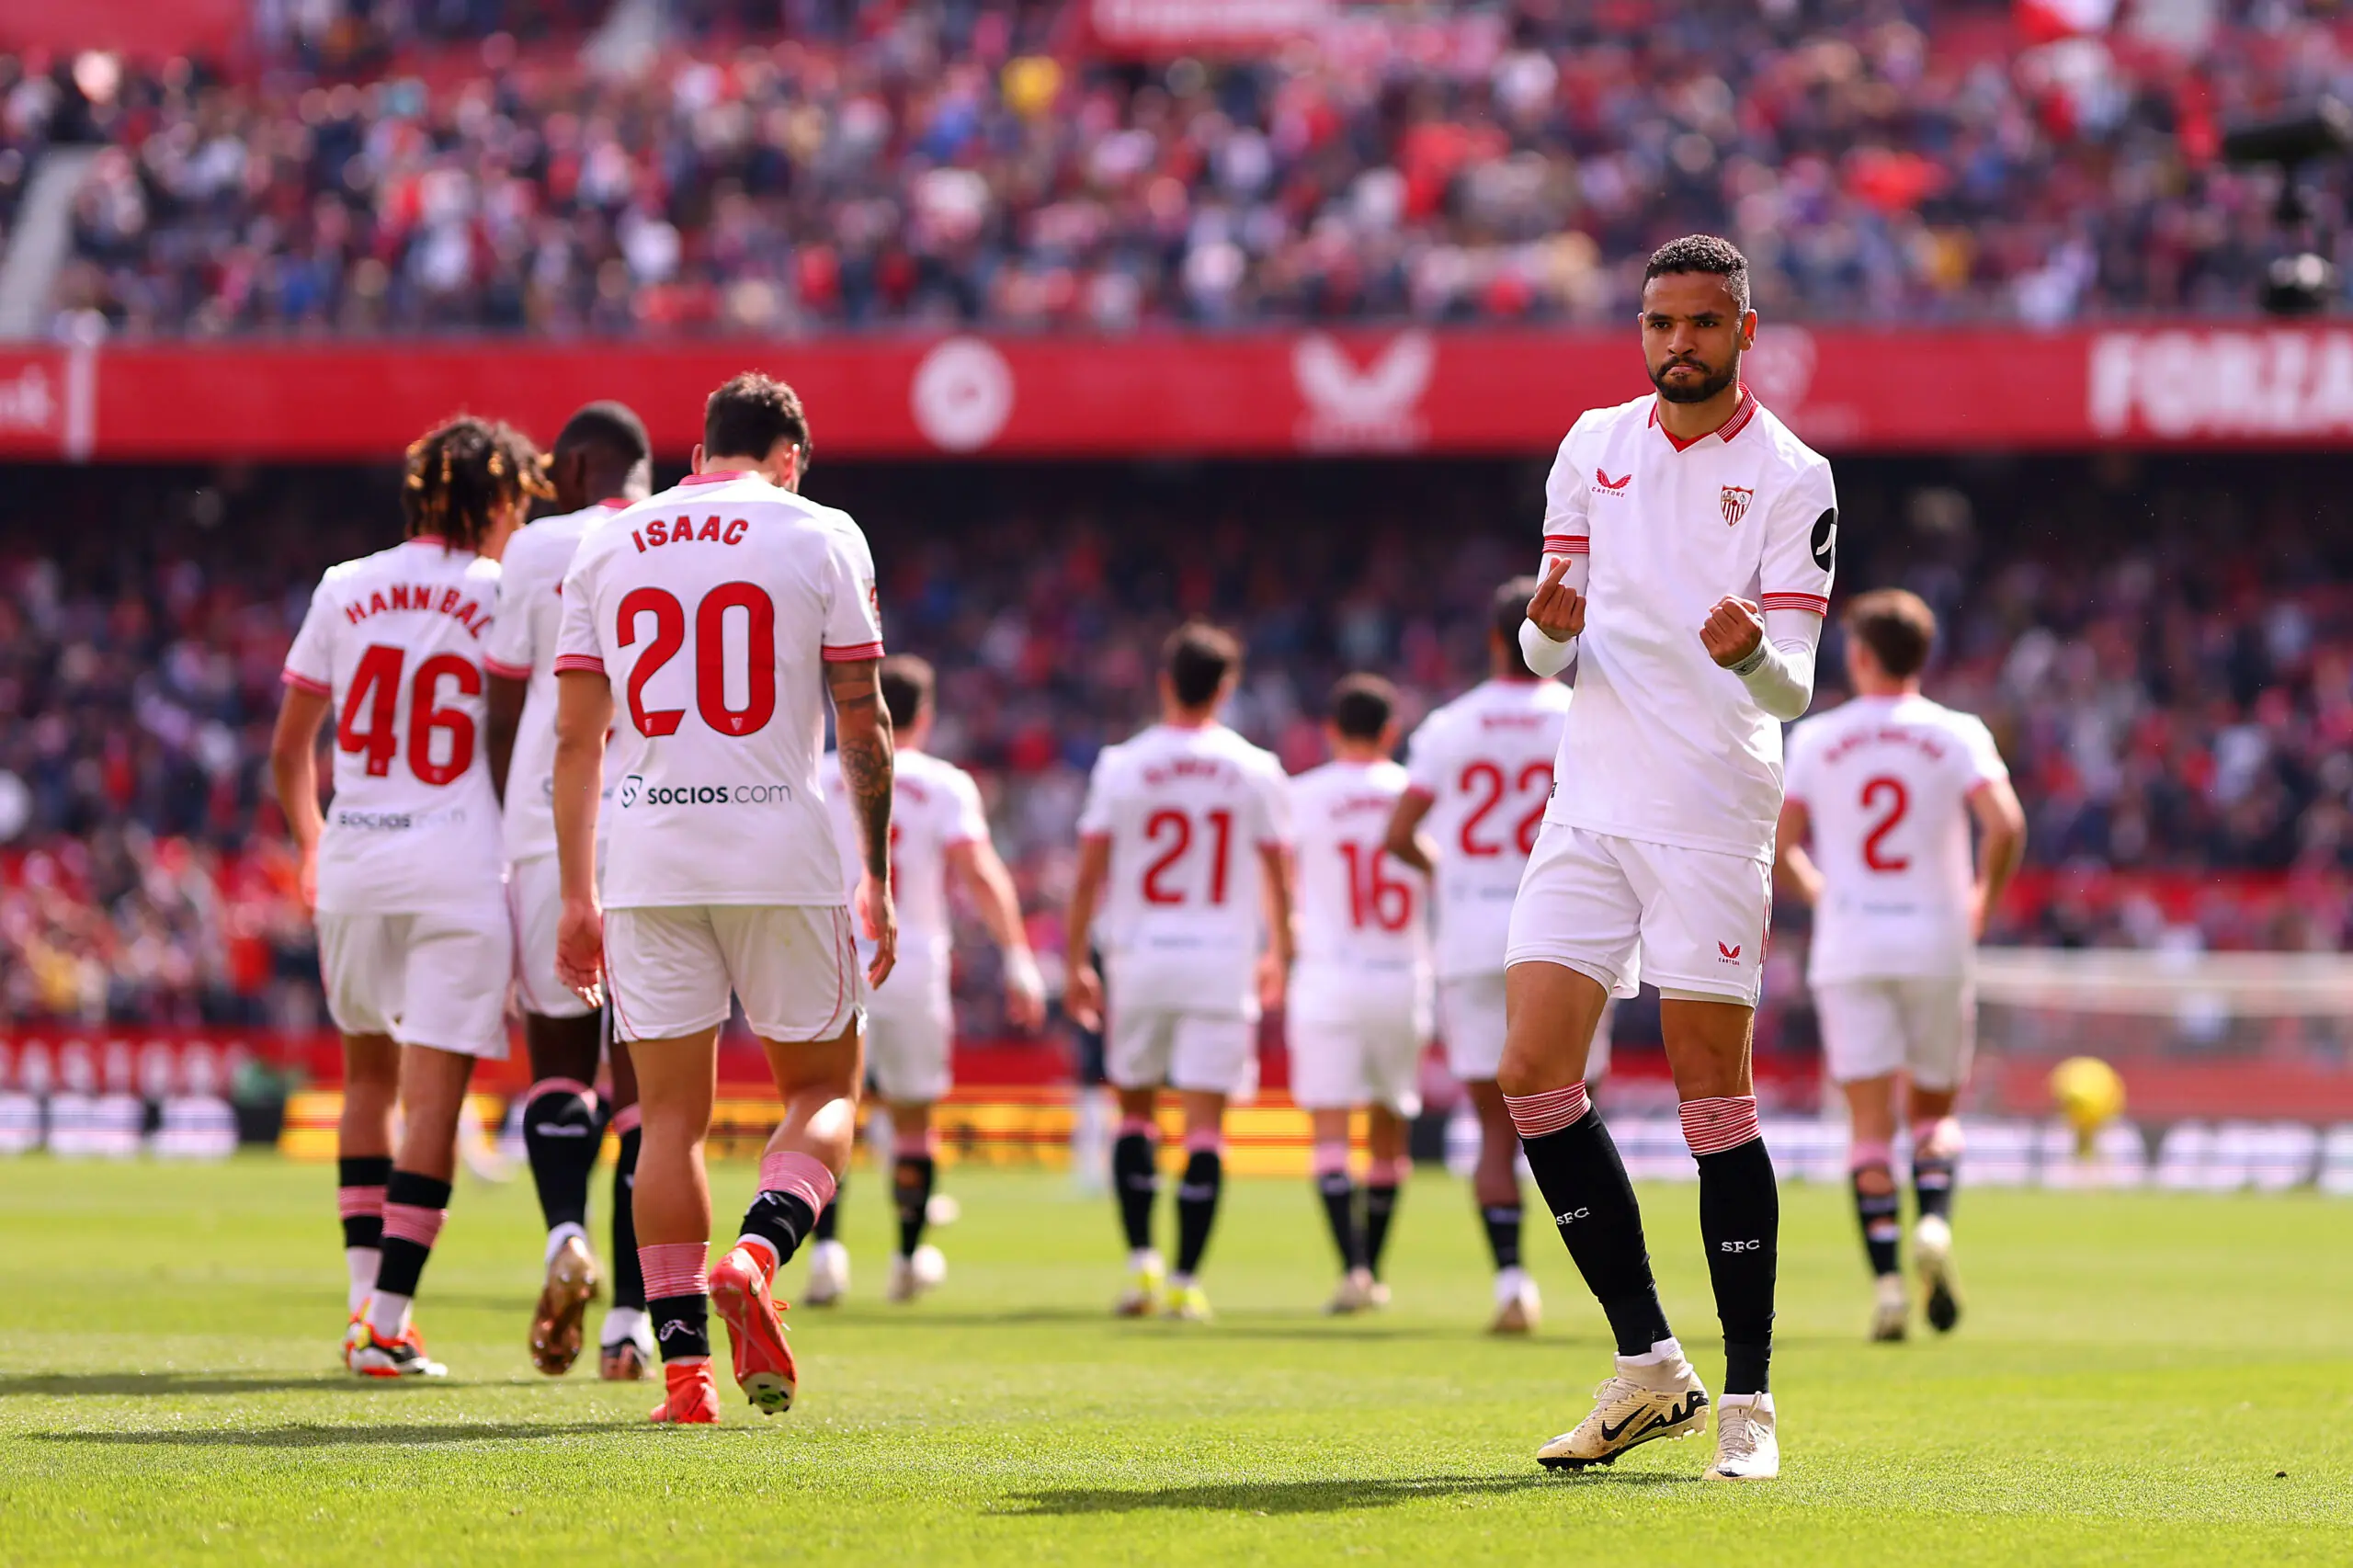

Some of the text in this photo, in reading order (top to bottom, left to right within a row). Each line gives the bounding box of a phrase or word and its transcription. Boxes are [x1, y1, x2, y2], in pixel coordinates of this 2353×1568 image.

[632, 515, 748, 553] ISAAC
[1591, 486, 1625, 497] CASTORE
[346, 582, 494, 640] HANNBAL
[616, 580, 776, 738] 20
[337, 642, 482, 786] 46
[1458, 758, 1556, 858] 22
[1859, 775, 1912, 871] 2
[1142, 805, 1233, 906] 21
[1337, 838, 1413, 932] 16
[1556, 1207, 1590, 1225] SFC
[1721, 1239, 1760, 1253] SFC
